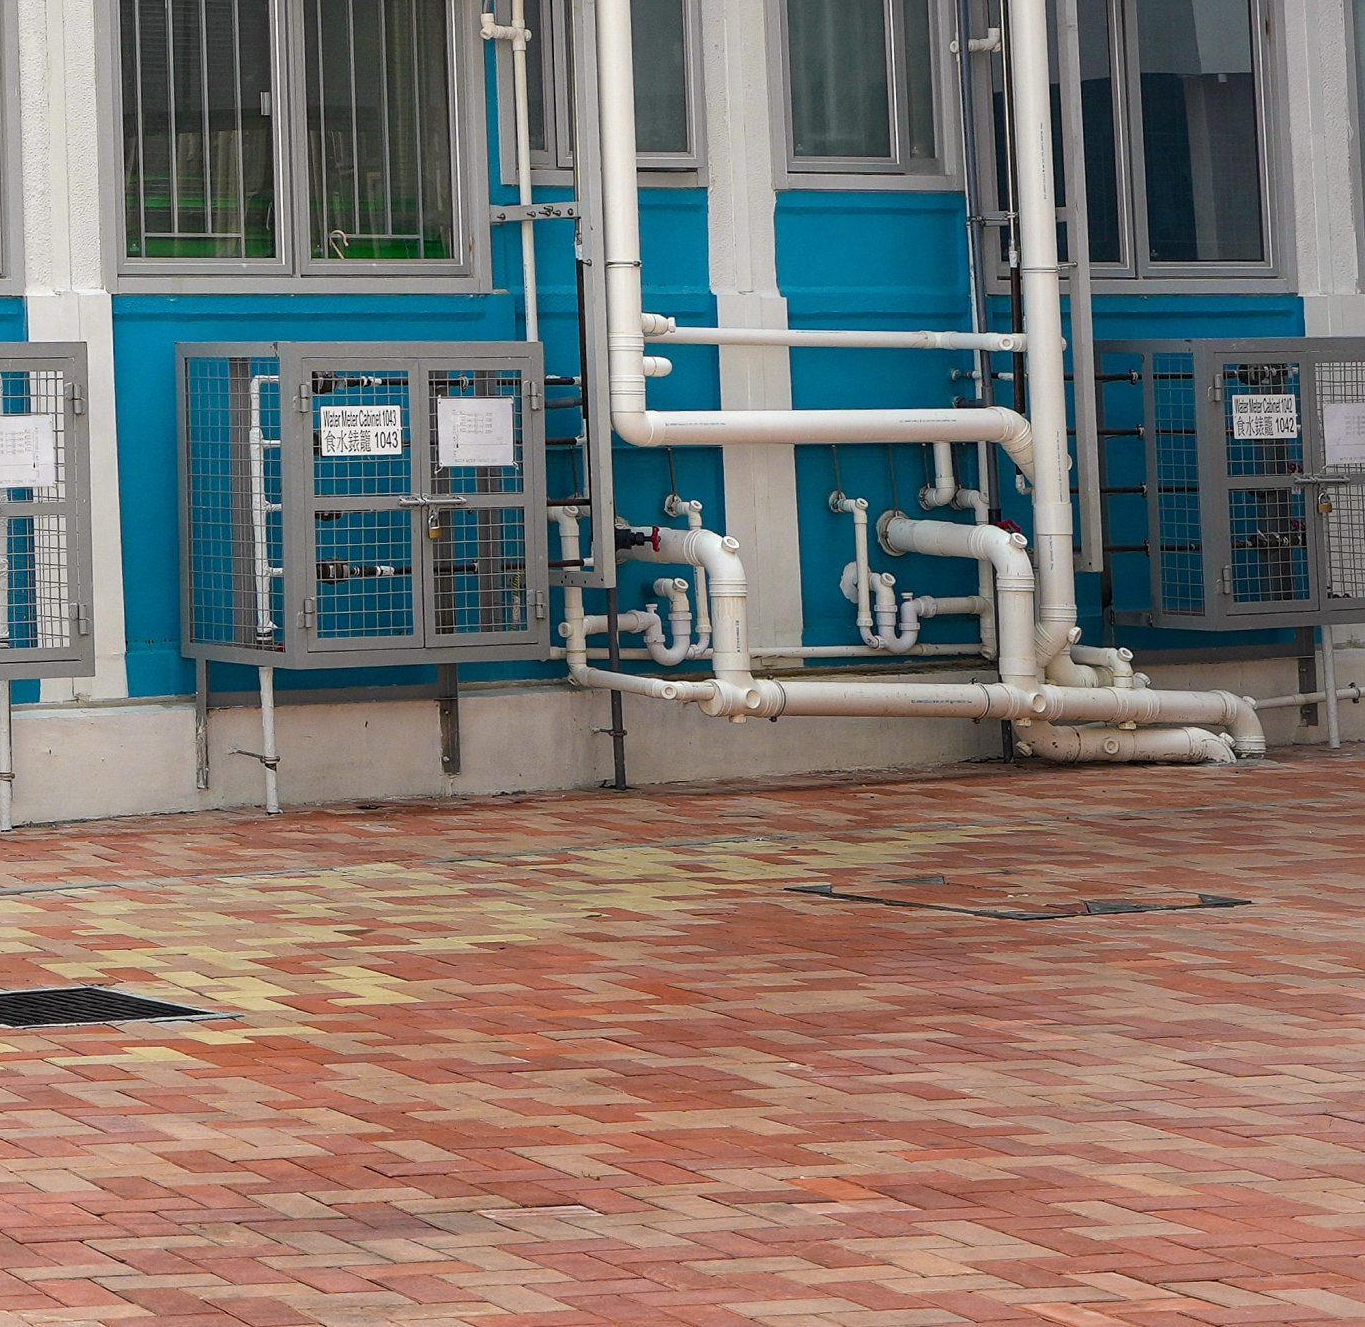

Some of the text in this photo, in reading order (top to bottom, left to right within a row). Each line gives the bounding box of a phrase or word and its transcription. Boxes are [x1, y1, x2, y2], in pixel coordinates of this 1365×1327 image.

[323, 409, 397, 428] Water Meter Cabinet 1043
[1276, 417, 1294, 433] 1042
[374, 431, 399, 449] 1043
